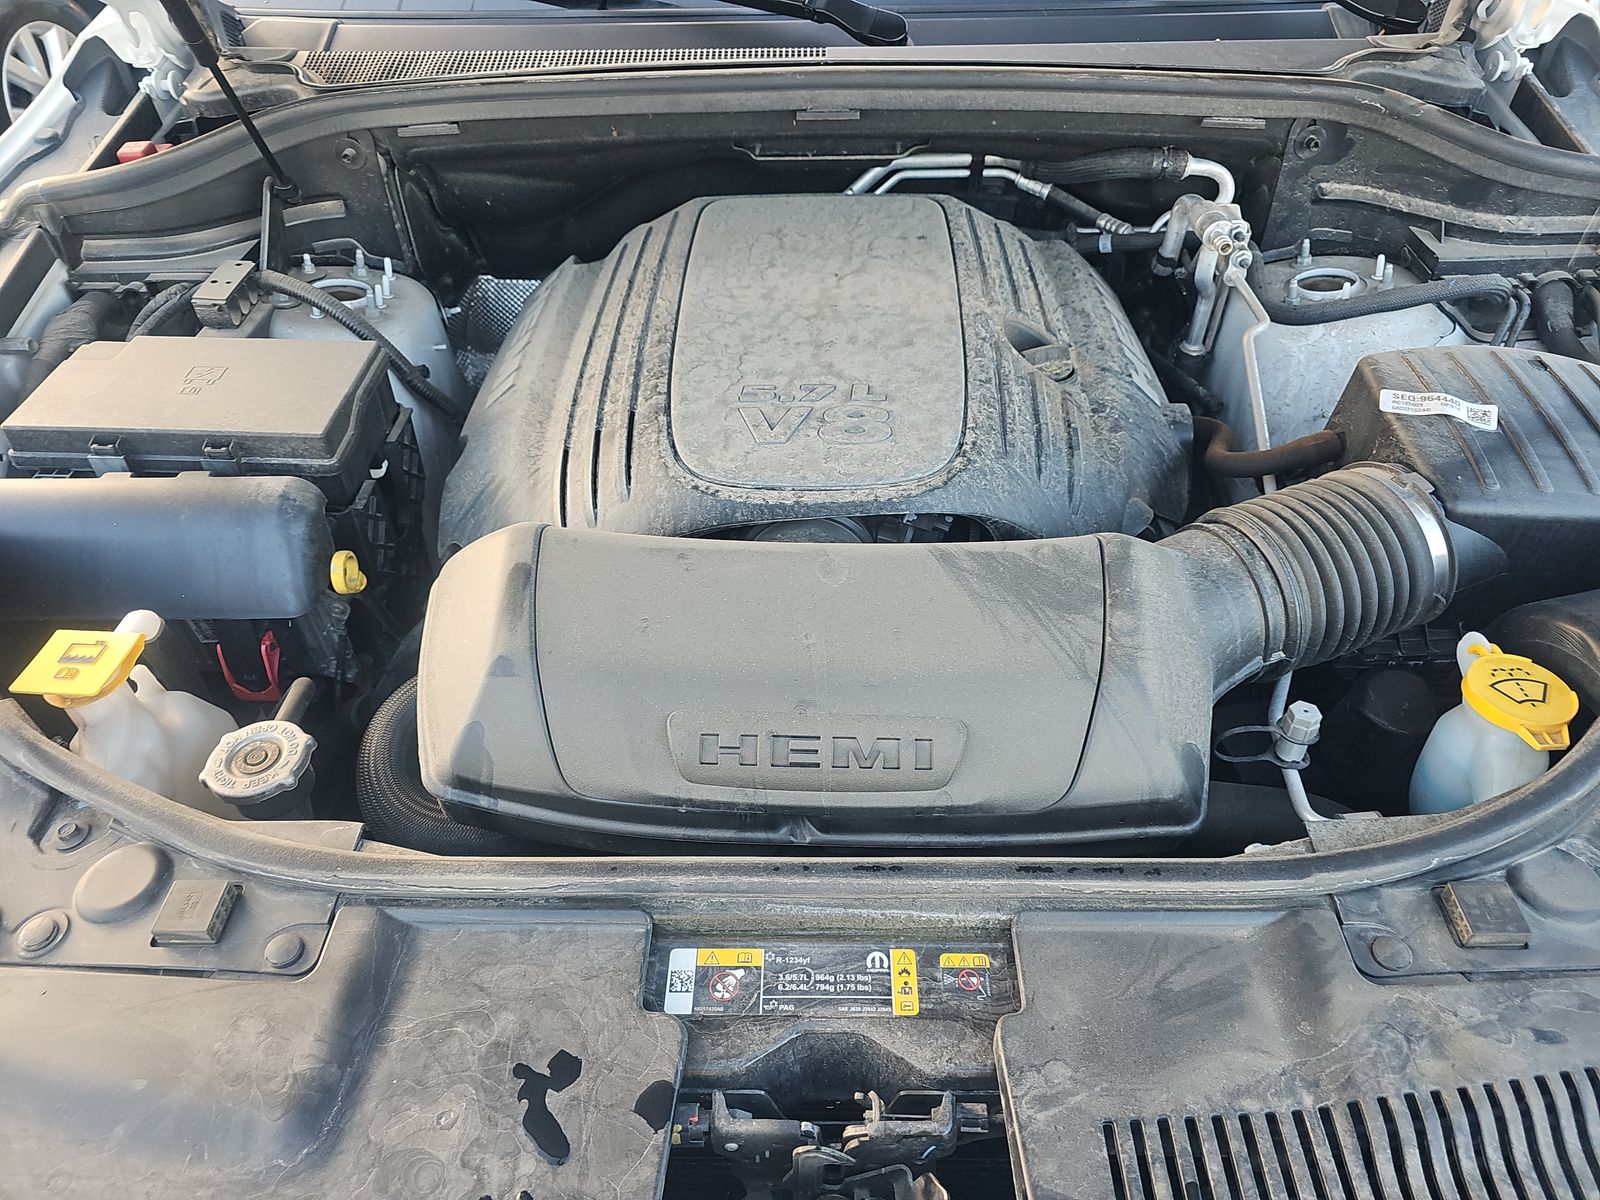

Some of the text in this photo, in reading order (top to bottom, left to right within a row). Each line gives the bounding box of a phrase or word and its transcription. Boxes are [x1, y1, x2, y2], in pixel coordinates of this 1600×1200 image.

[737, 404, 893, 445] V8
[699, 733, 934, 771] HEMI
[243, 769, 279, 788] KEEP
[776, 957, 811, 965] R-1234yf
[815, 974, 834, 982] 964g
[836, 974, 855, 982] (2.13
[857, 974, 872, 982] lbs)
[815, 984, 834, 993] 794g
[836, 984, 855, 992] (1.75
[857, 984, 872, 992] lbs)
